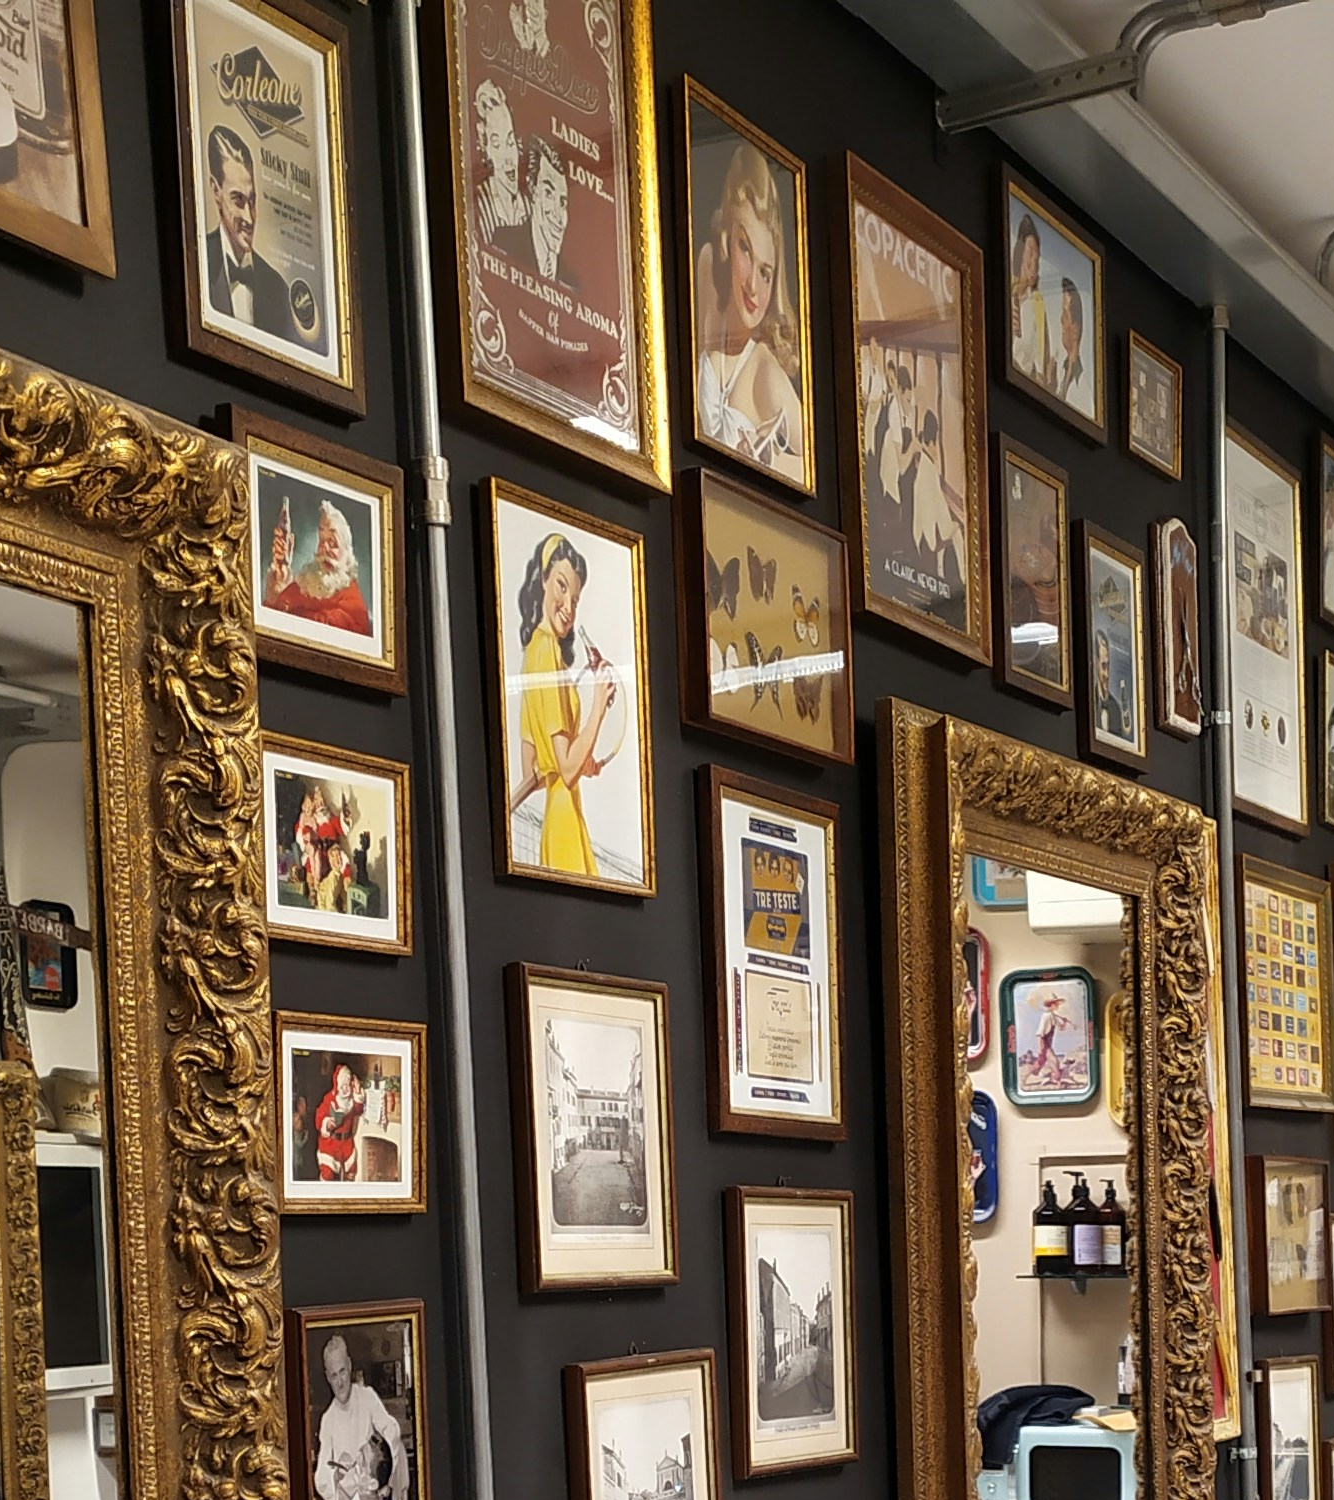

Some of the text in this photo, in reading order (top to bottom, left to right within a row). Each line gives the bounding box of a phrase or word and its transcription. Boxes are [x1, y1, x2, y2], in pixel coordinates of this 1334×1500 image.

[216, 52, 303, 105] Corleone
[261, 147, 287, 179] Sticky
[551, 116, 600, 162] LADIES
[854, 205, 954, 304] COPACETIC
[481, 251, 619, 340] THE PLEASING AROMA
[884, 558, 891, 573] A
